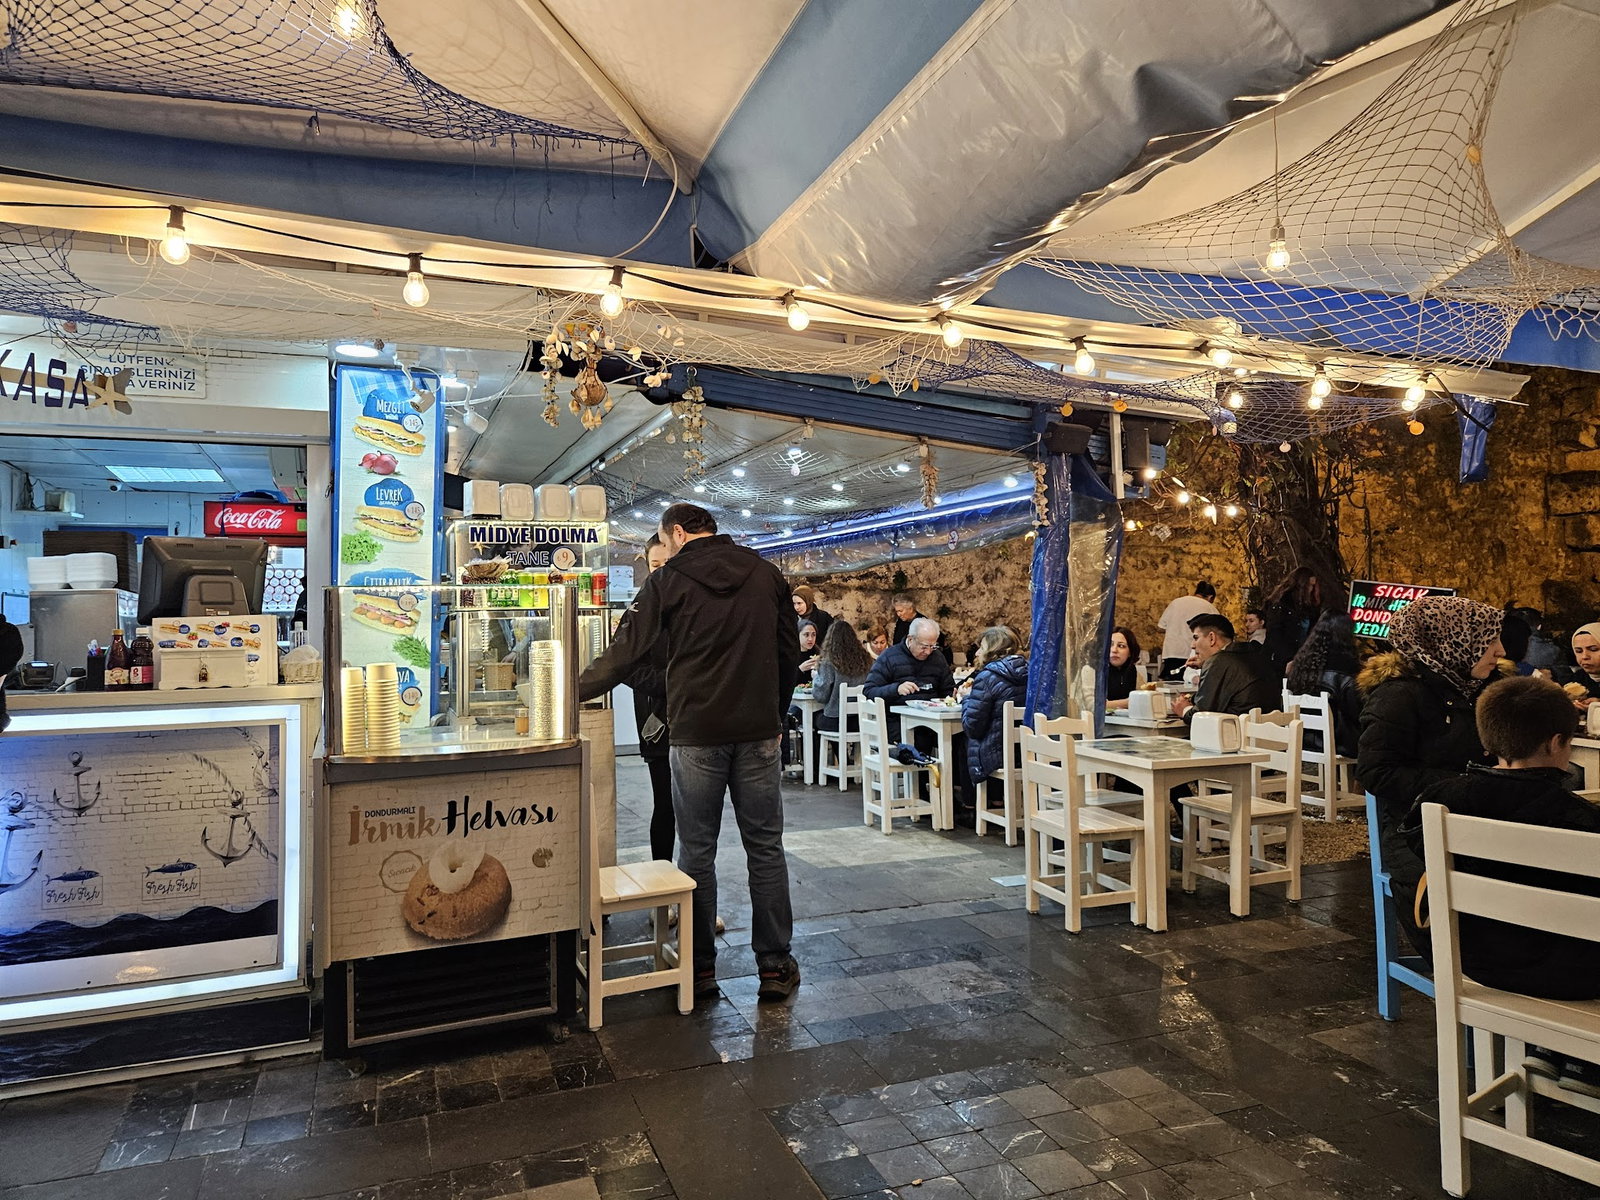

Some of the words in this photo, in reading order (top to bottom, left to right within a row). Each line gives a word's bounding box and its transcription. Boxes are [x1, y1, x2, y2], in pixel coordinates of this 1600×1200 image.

[109, 353, 164, 366] LÜTFEN
[139, 379, 196, 391] VERİNİZ
[376, 487, 403, 501] LEVREK
[469, 524, 531, 544] MİDYE
[534, 526, 599, 544] DOLMA
[506, 550, 550, 566] TANE
[1375, 585, 1429, 600] SICAK
[364, 806, 417, 819] DONDURMALI
[441, 795, 559, 838] Helvası
[145, 881, 175, 895] Fresh
[175, 878, 198, 892] Fish
[45, 889, 76, 903] Fresh
[76, 886, 100, 902] Fish
